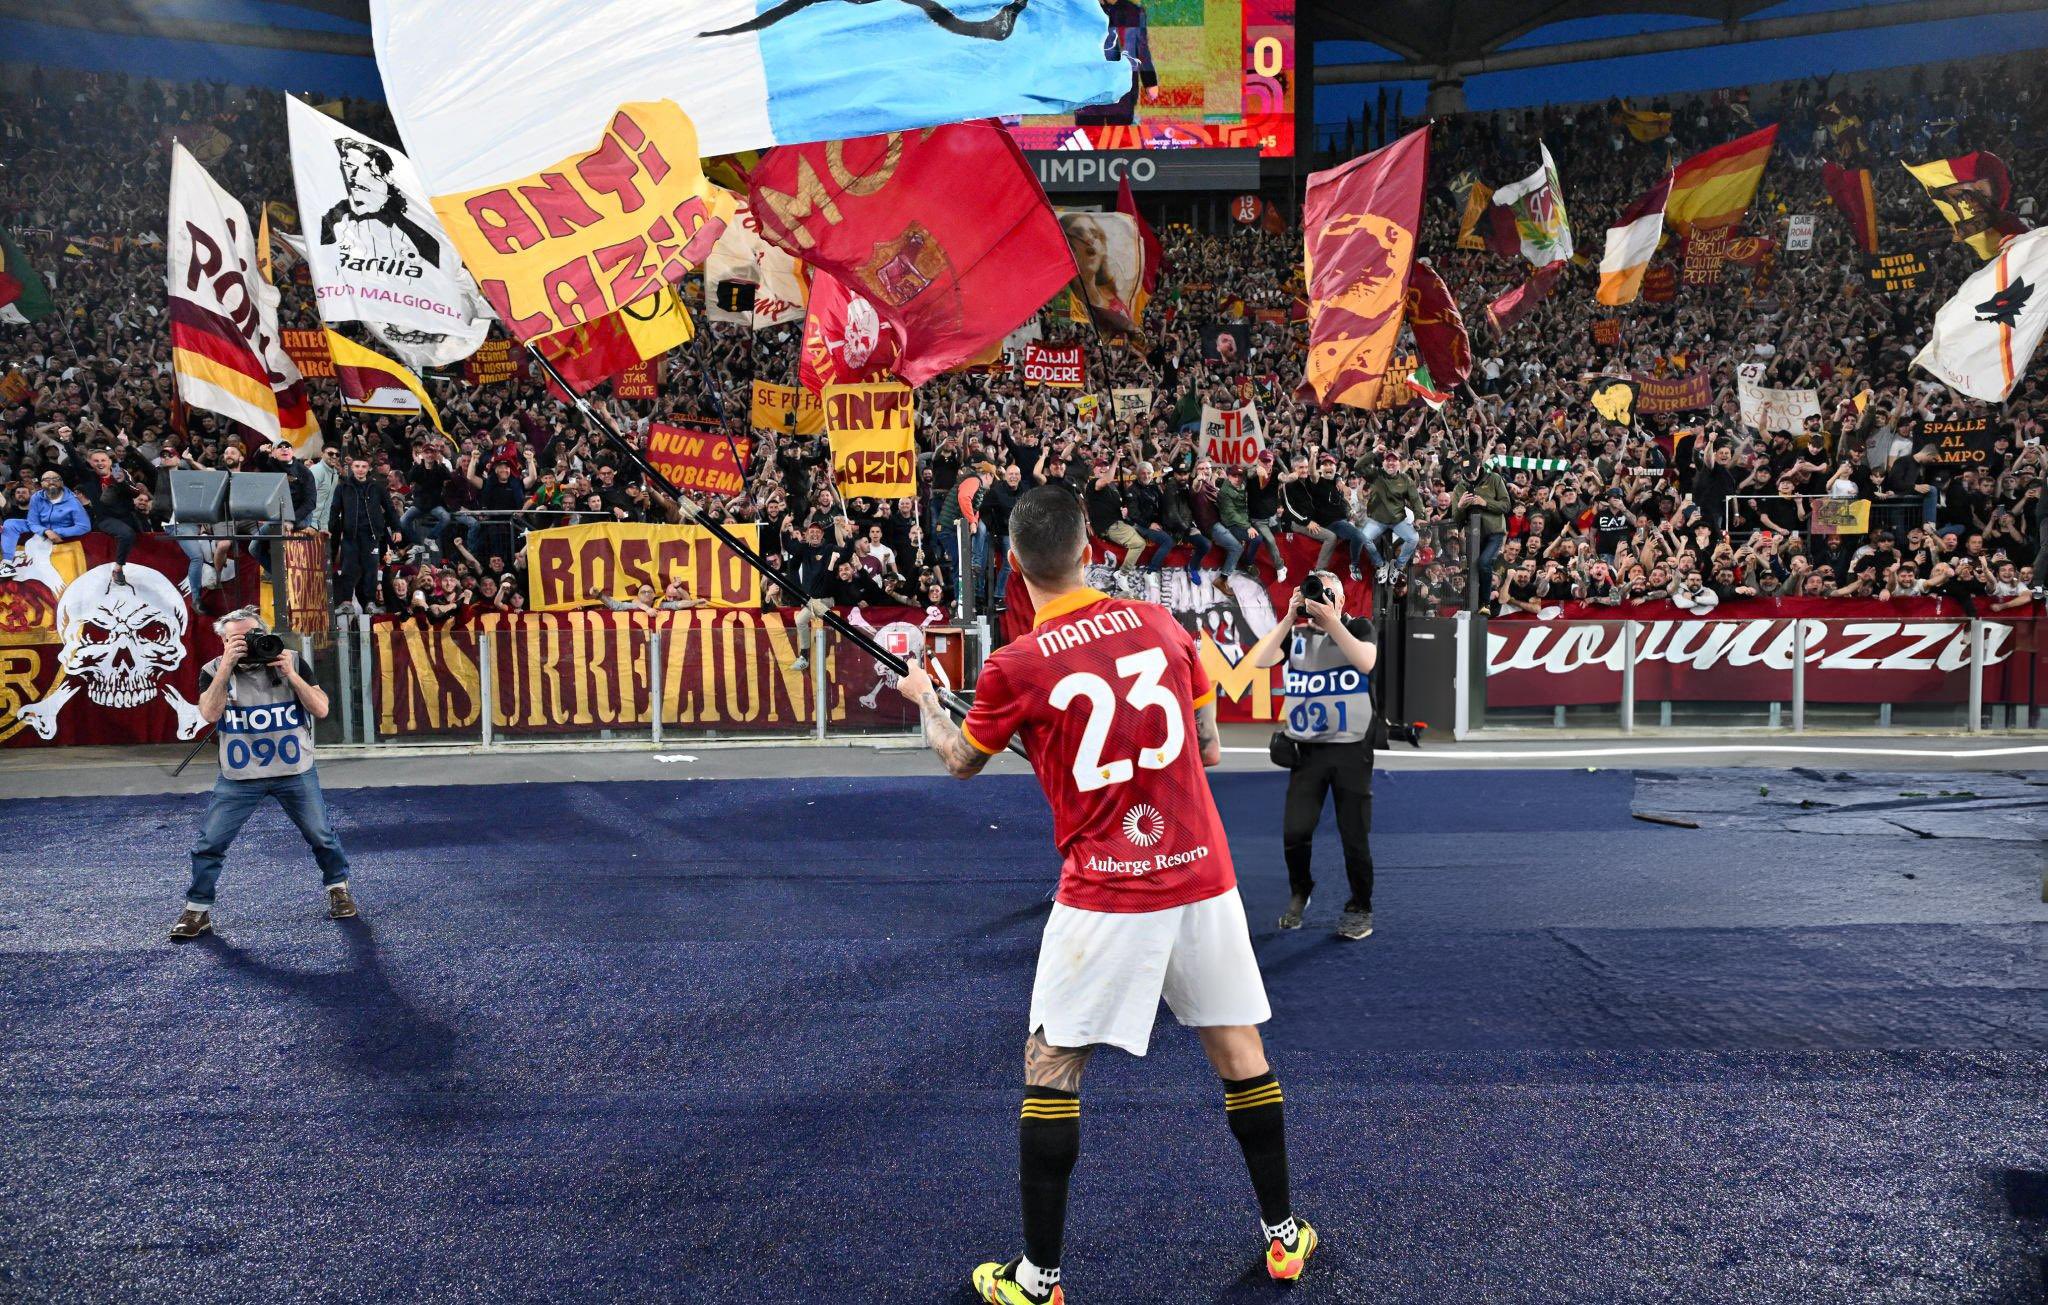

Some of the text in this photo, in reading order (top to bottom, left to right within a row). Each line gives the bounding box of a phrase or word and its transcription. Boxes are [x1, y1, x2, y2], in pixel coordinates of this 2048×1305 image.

[1253, 36, 1283, 77] 0
[1259, 135, 1277, 148] +5
[1040, 157, 1156, 182] IMPICO
[1239, 195, 1254, 208] 19
[1238, 208, 1256, 221] AS
[1790, 227, 1812, 236] ROMA
[1879, 253, 1915, 268] TUTTO
[1871, 261, 1926, 279] MI PARLA
[1886, 280, 1899, 291] DI
[479, 340, 512, 351] ESSUNO
[476, 351, 508, 361] FERMA
[298, 360, 337, 377] ARGO
[471, 360, 518, 374] IL NOSTRO
[1024, 364, 1081, 382] GODERE
[622, 373, 648, 384] STAR
[618, 385, 655, 396] CON TE
[758, 389, 776, 408] SE
[1220, 411, 1242, 438] TI
[1923, 418, 1987, 434] SPALLE
[650, 431, 705, 458] NUN
[1940, 435, 1966, 447] AL
[1207, 437, 1259, 465] AMO
[1934, 450, 1986, 463] AMPO
[1599, 515, 1627, 528] EA7
[538, 537, 752, 605] ROSCIO
[1036, 607, 1143, 657] MANCINI
[372, 610, 846, 735] INSURREZIONE
[1285, 669, 1361, 694] PHOTO
[1048, 646, 1185, 792] 23
[1289, 700, 1348, 733] 021
[226, 734, 301, 770] 090
[1084, 854, 1152, 876] Auberge
